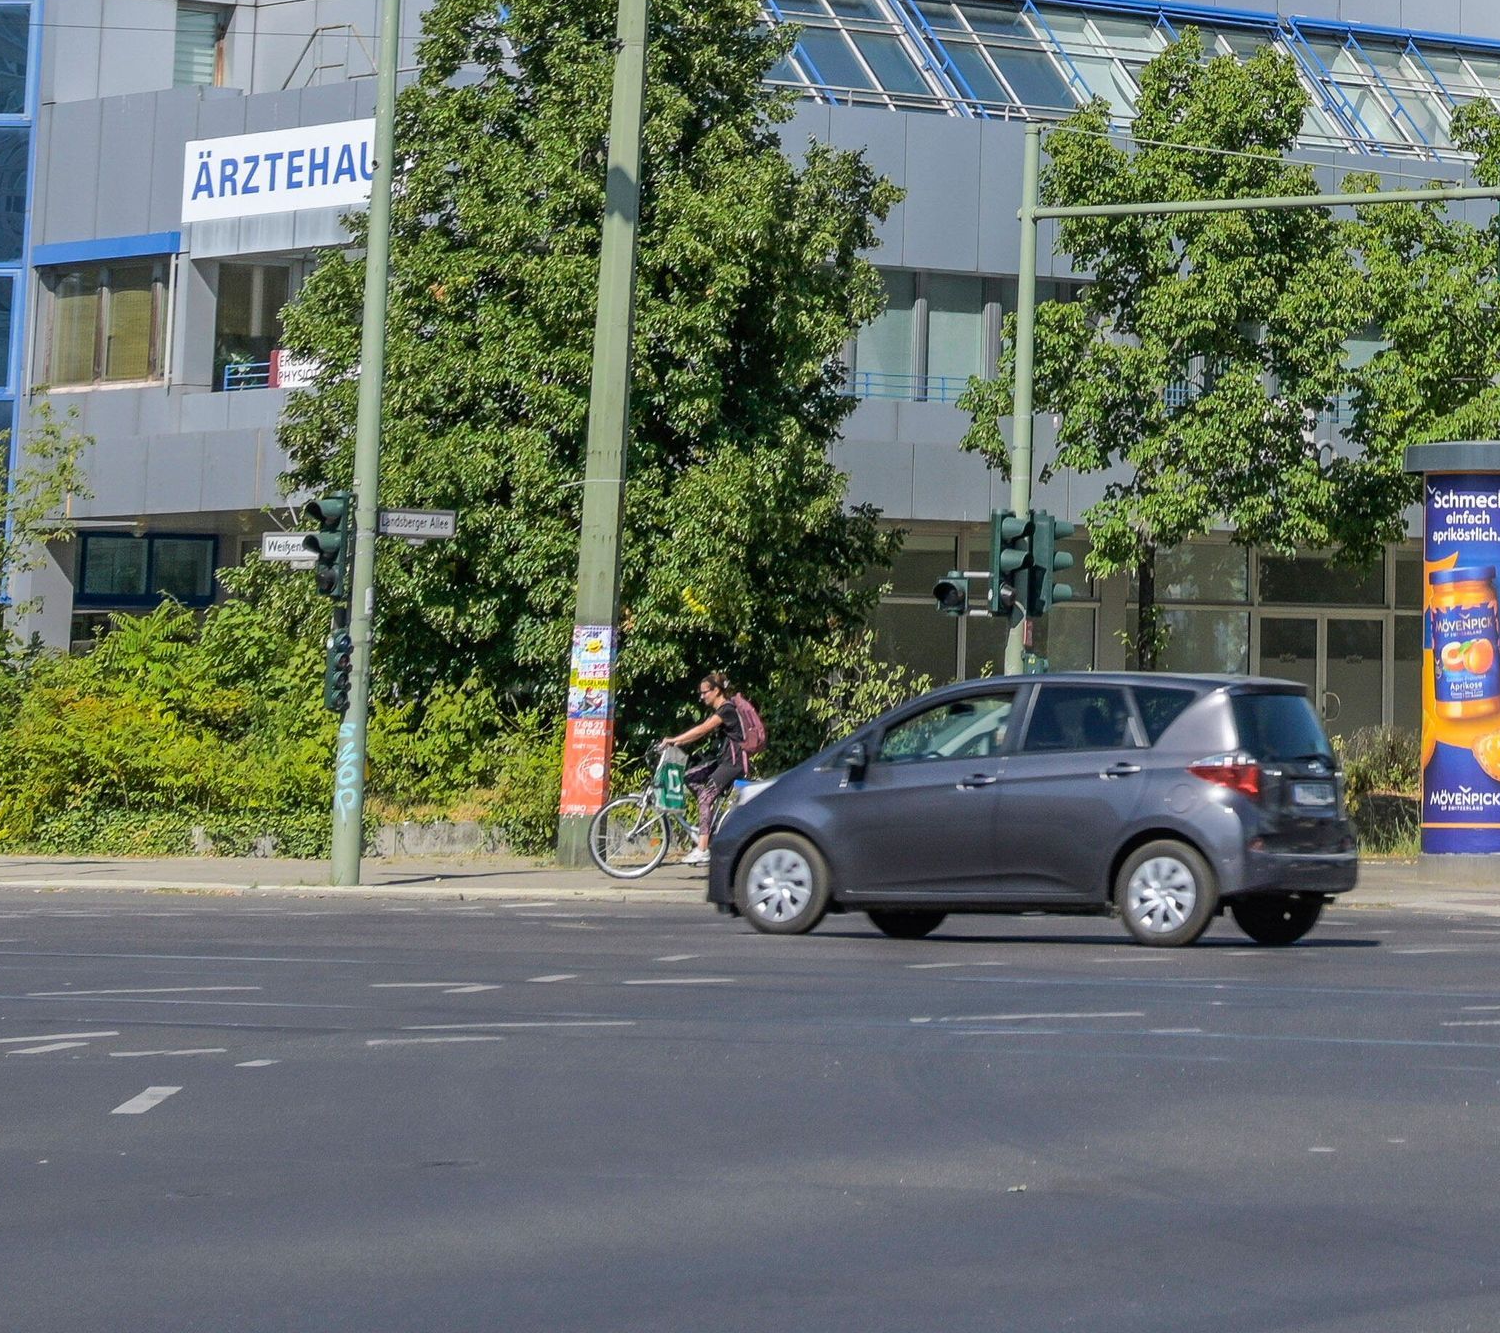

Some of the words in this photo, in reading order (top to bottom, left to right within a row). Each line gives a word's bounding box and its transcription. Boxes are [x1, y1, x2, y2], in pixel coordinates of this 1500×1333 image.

[381, 513, 428, 531] Landsberger
[430, 517, 449, 530] Allee
[1446, 510, 1490, 524] einfach
[1433, 527, 1500, 545] apriköstlich.
[1436, 616, 1493, 633] MÖVENPICK
[1450, 682, 1483, 692] Aprikose
[1430, 788, 1500, 805] MÖVENPICK
